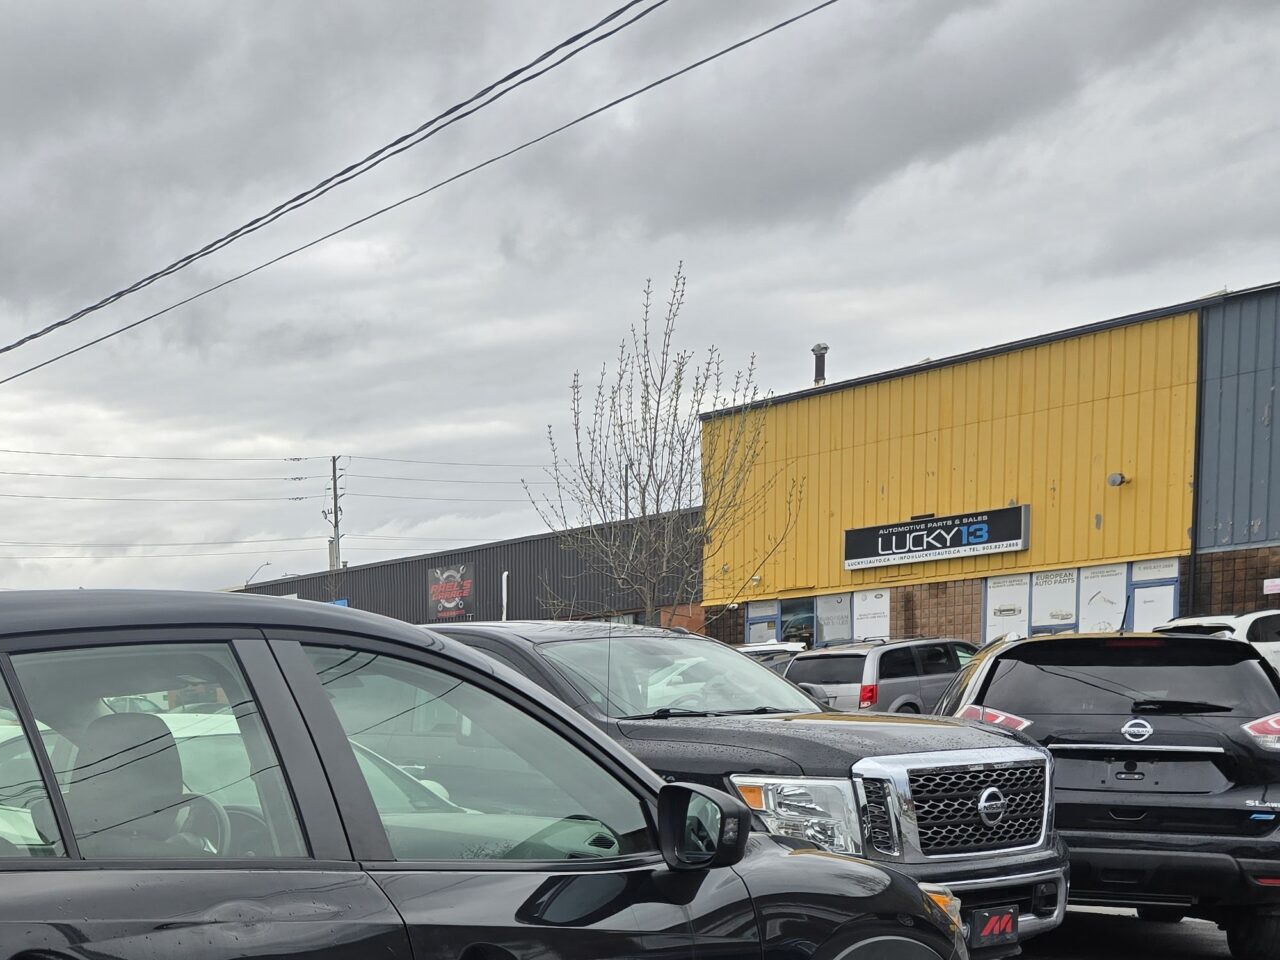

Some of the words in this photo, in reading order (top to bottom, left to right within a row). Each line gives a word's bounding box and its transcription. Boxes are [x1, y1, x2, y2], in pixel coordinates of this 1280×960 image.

[879, 523, 926, 534] AUTOMOTIVE
[927, 519, 953, 528] PARTS
[962, 515, 988, 523] SALES
[1035, 572, 1074, 581] EUROPEAN
[1034, 579, 1053, 587] AUTO
[1053, 577, 1075, 585] PARTS
